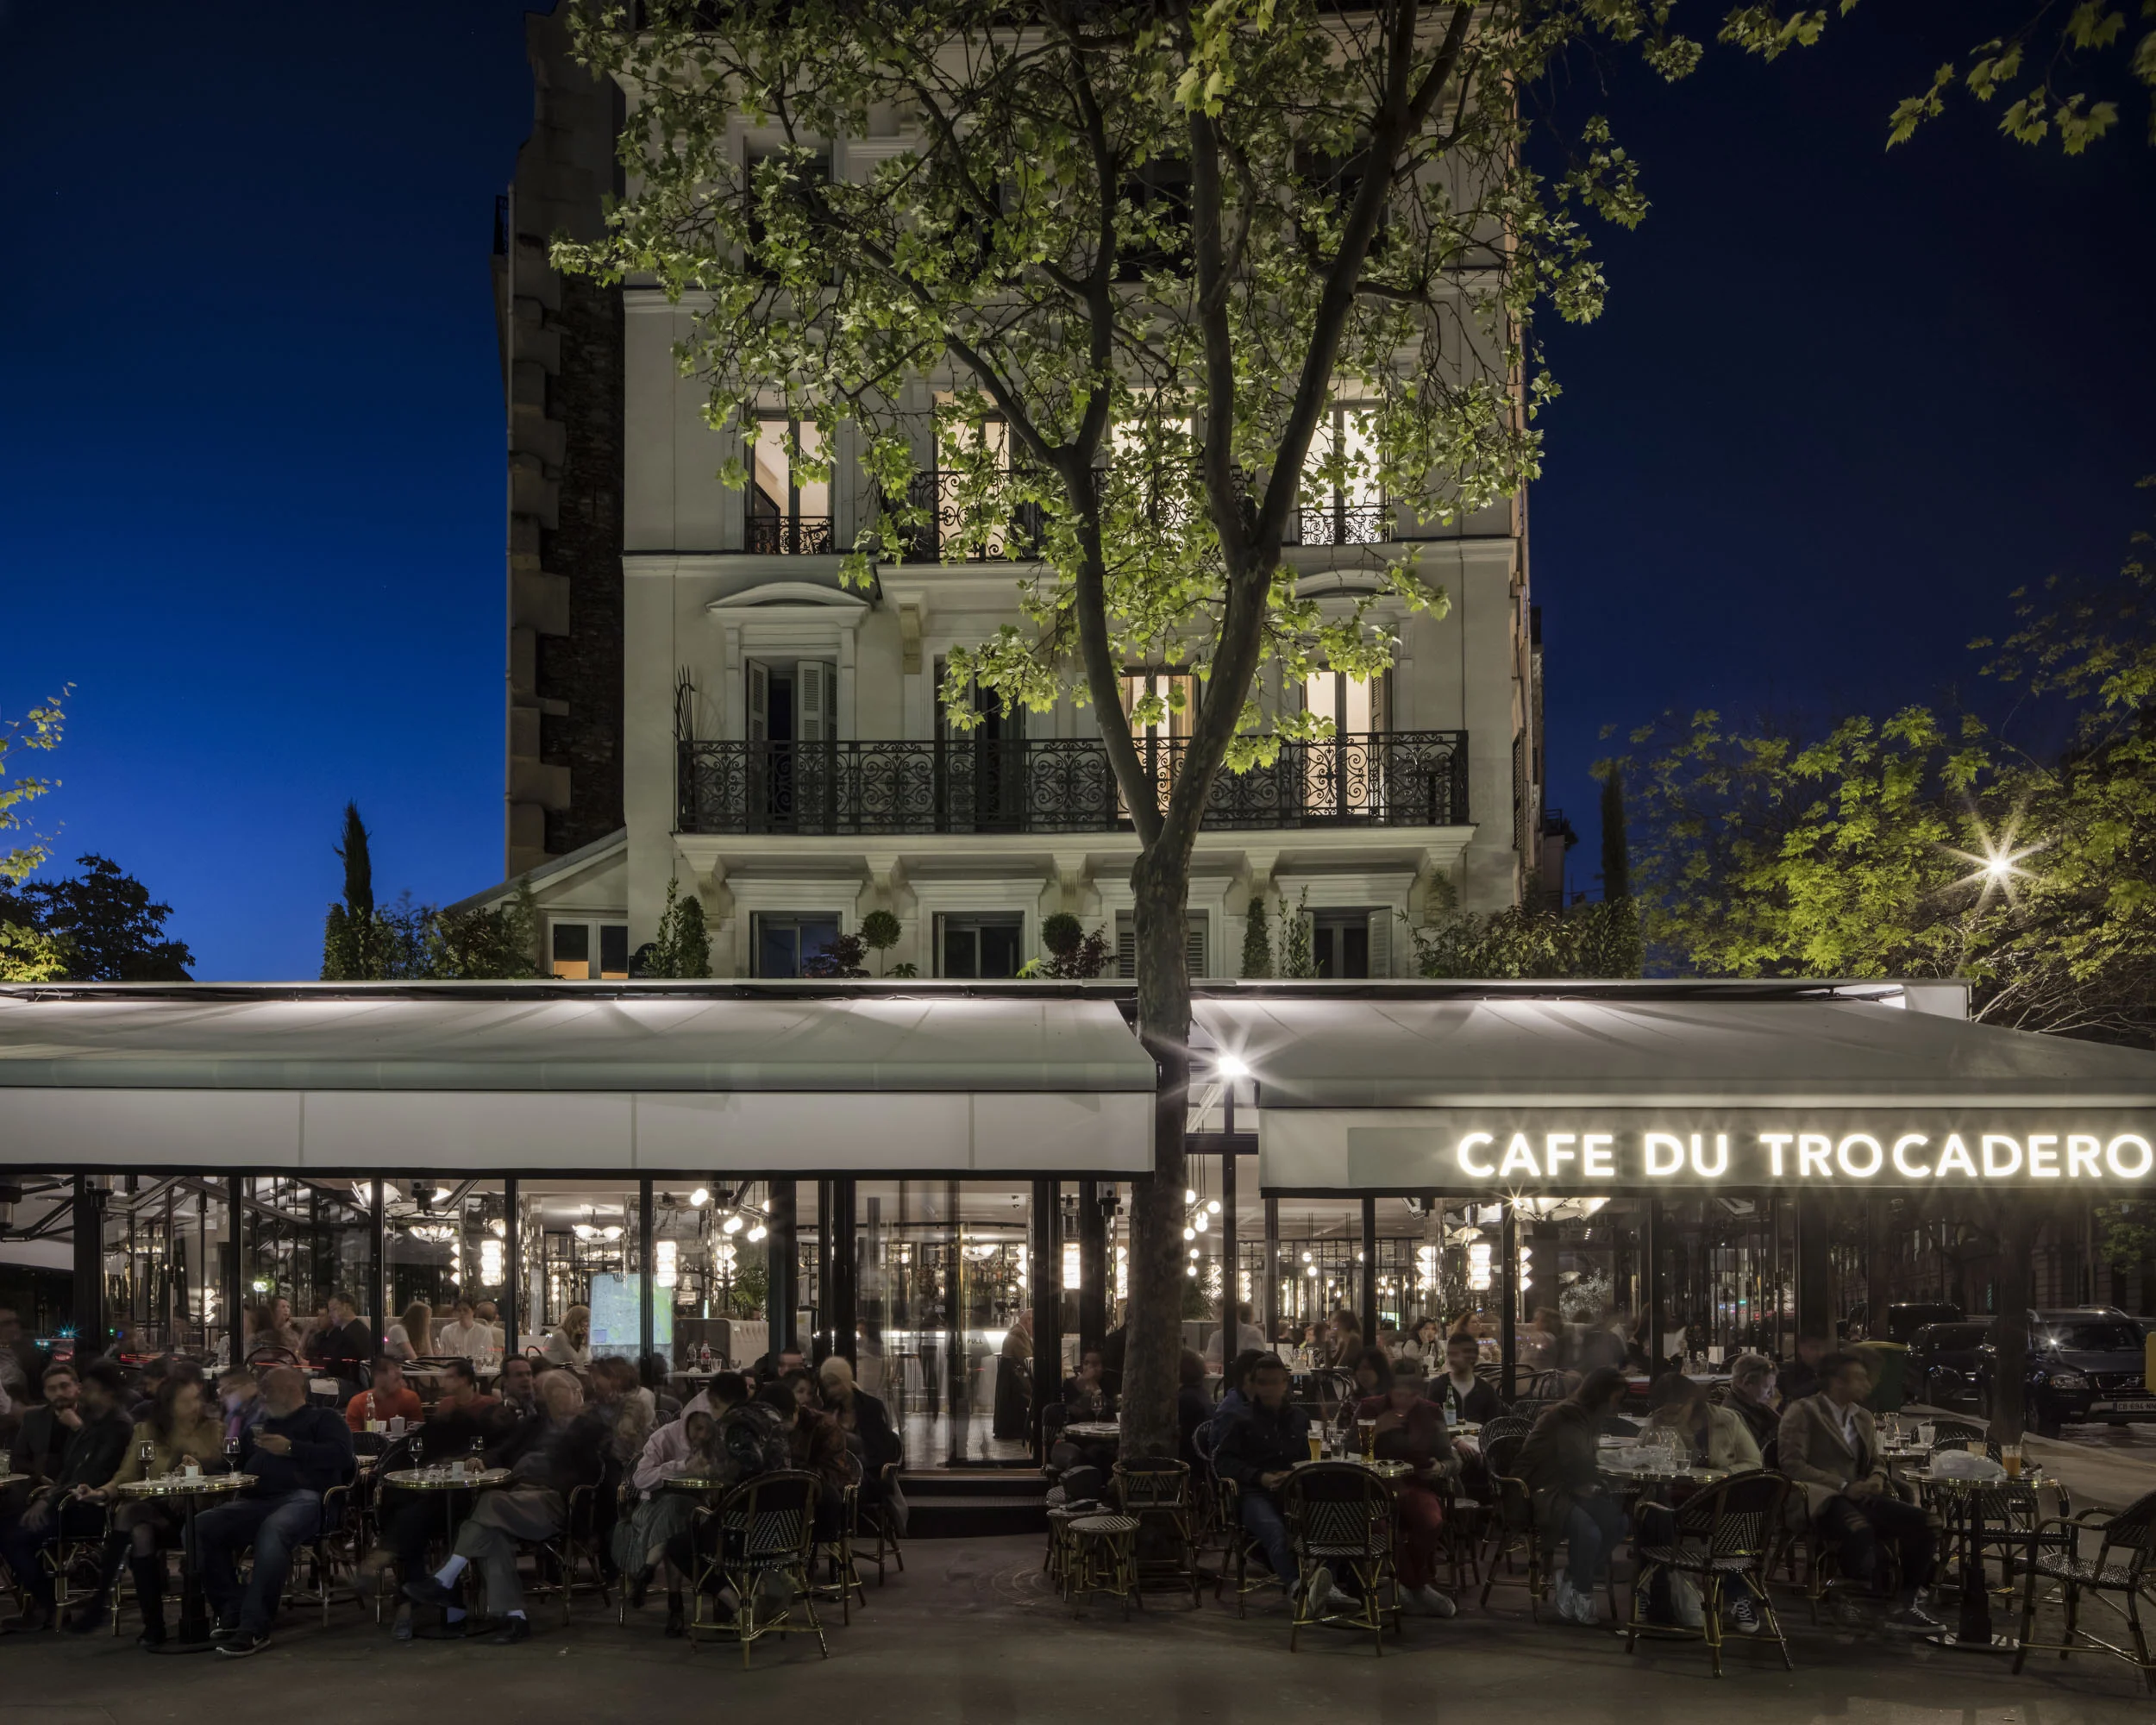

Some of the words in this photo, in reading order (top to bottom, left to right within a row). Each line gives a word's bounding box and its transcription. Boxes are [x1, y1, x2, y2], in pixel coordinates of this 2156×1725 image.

[1457, 1132, 1614, 1176] CAFE
[1645, 1133, 1728, 1176] DU
[1759, 1133, 2153, 1178] TROCADERO
